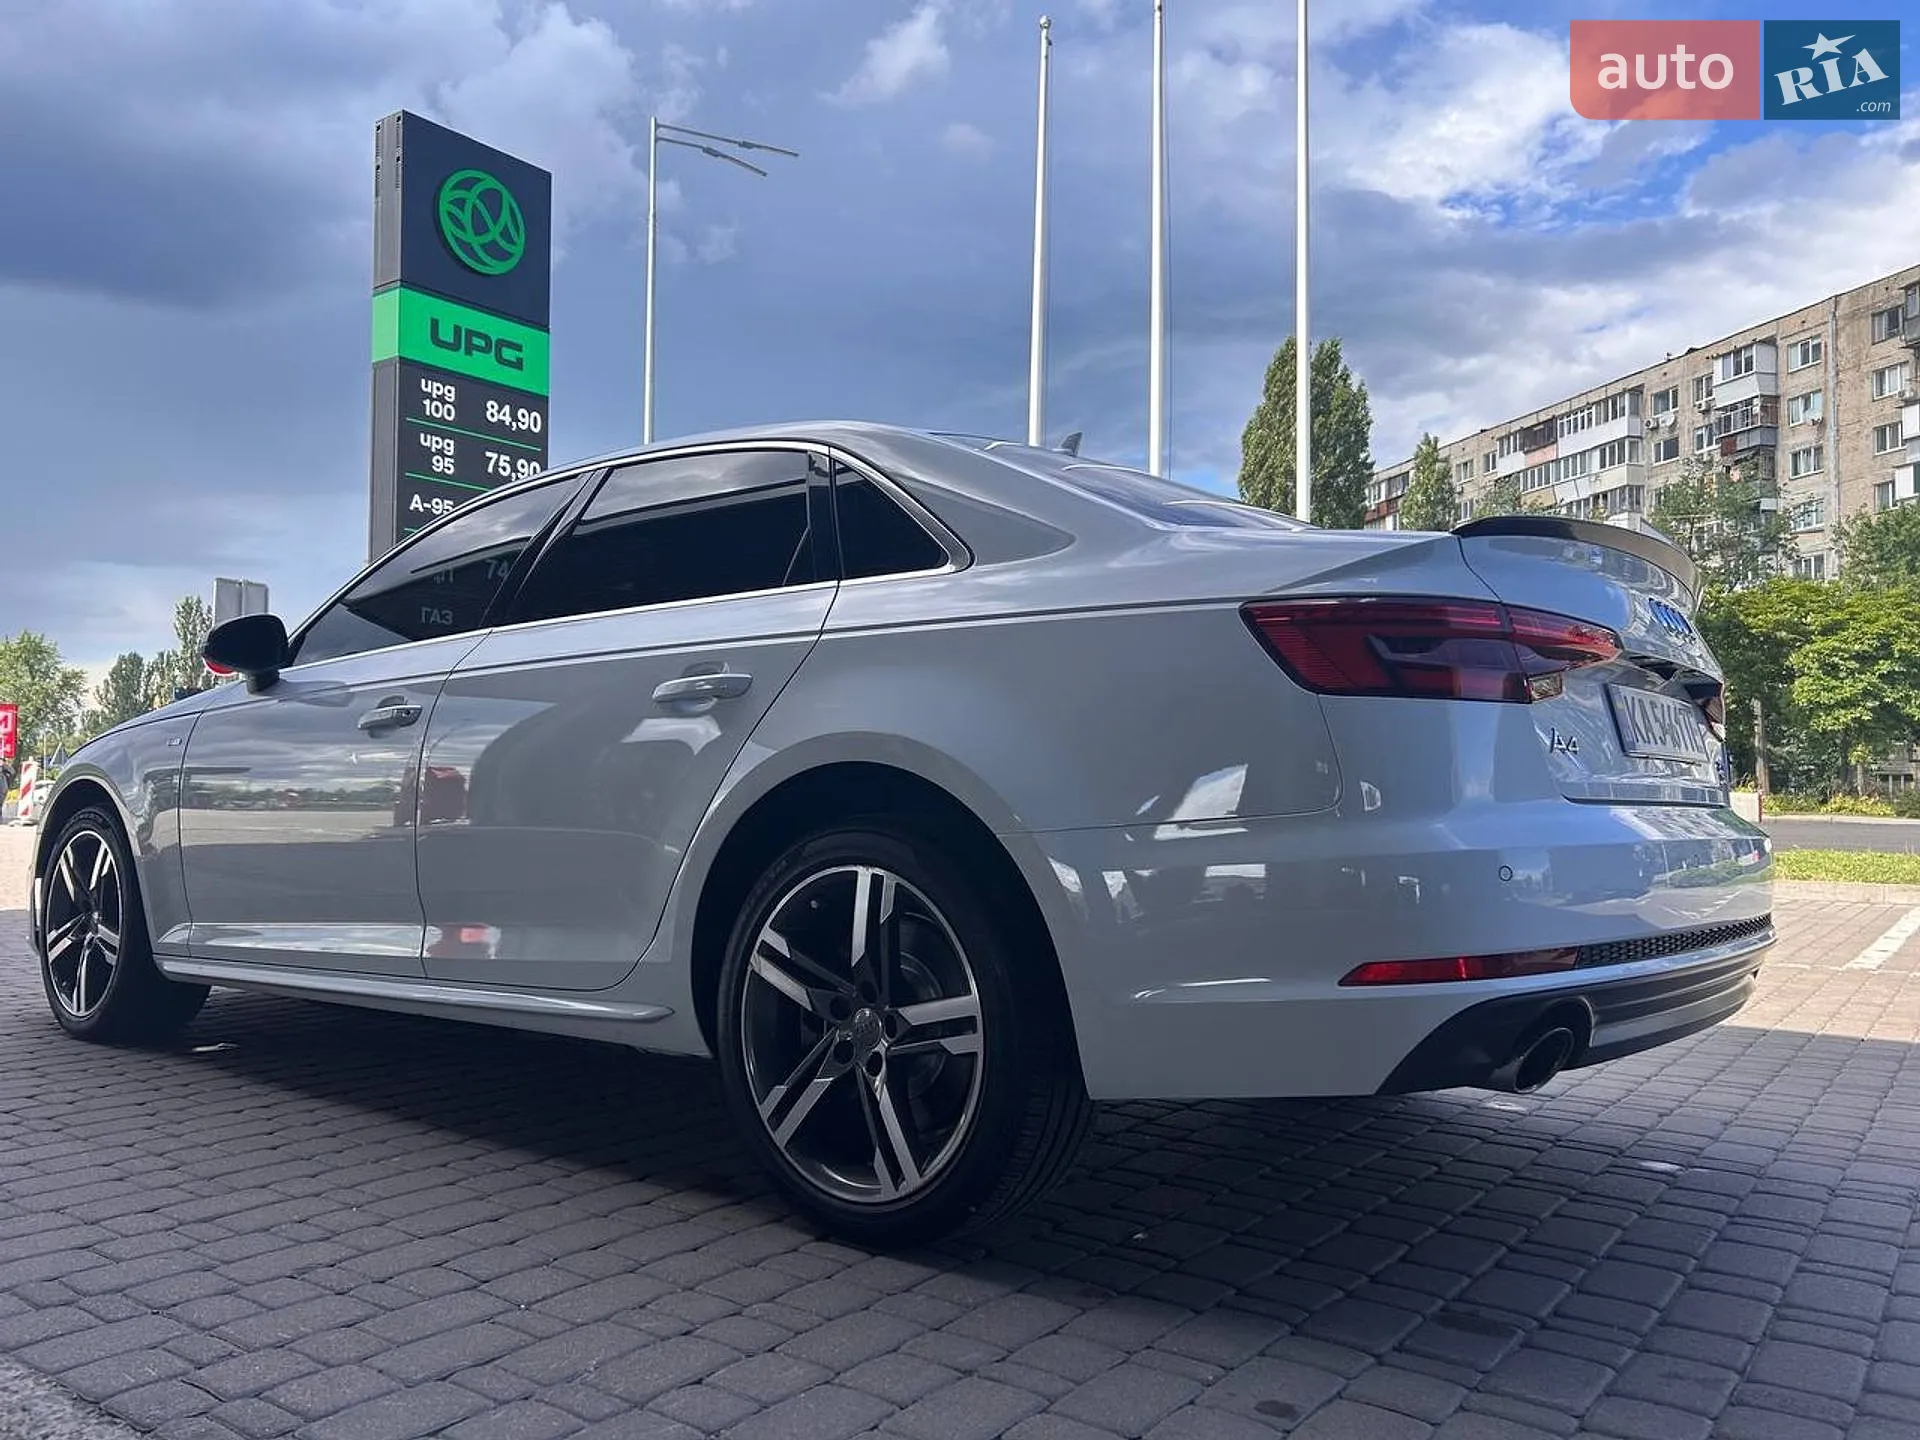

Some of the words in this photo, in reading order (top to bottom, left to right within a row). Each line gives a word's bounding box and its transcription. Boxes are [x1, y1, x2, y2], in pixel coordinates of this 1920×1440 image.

[430, 317, 524, 372] UPG
[421, 378, 456, 402] upg
[422, 399, 456, 421] 100
[485, 400, 542, 434] 84,90
[420, 431, 455, 456] upg
[431, 455, 455, 475] 95
[484, 451, 541, 481] 75,90
[420, 606, 454, 626] ГАЗ
[1550, 727, 1579, 755] A4
